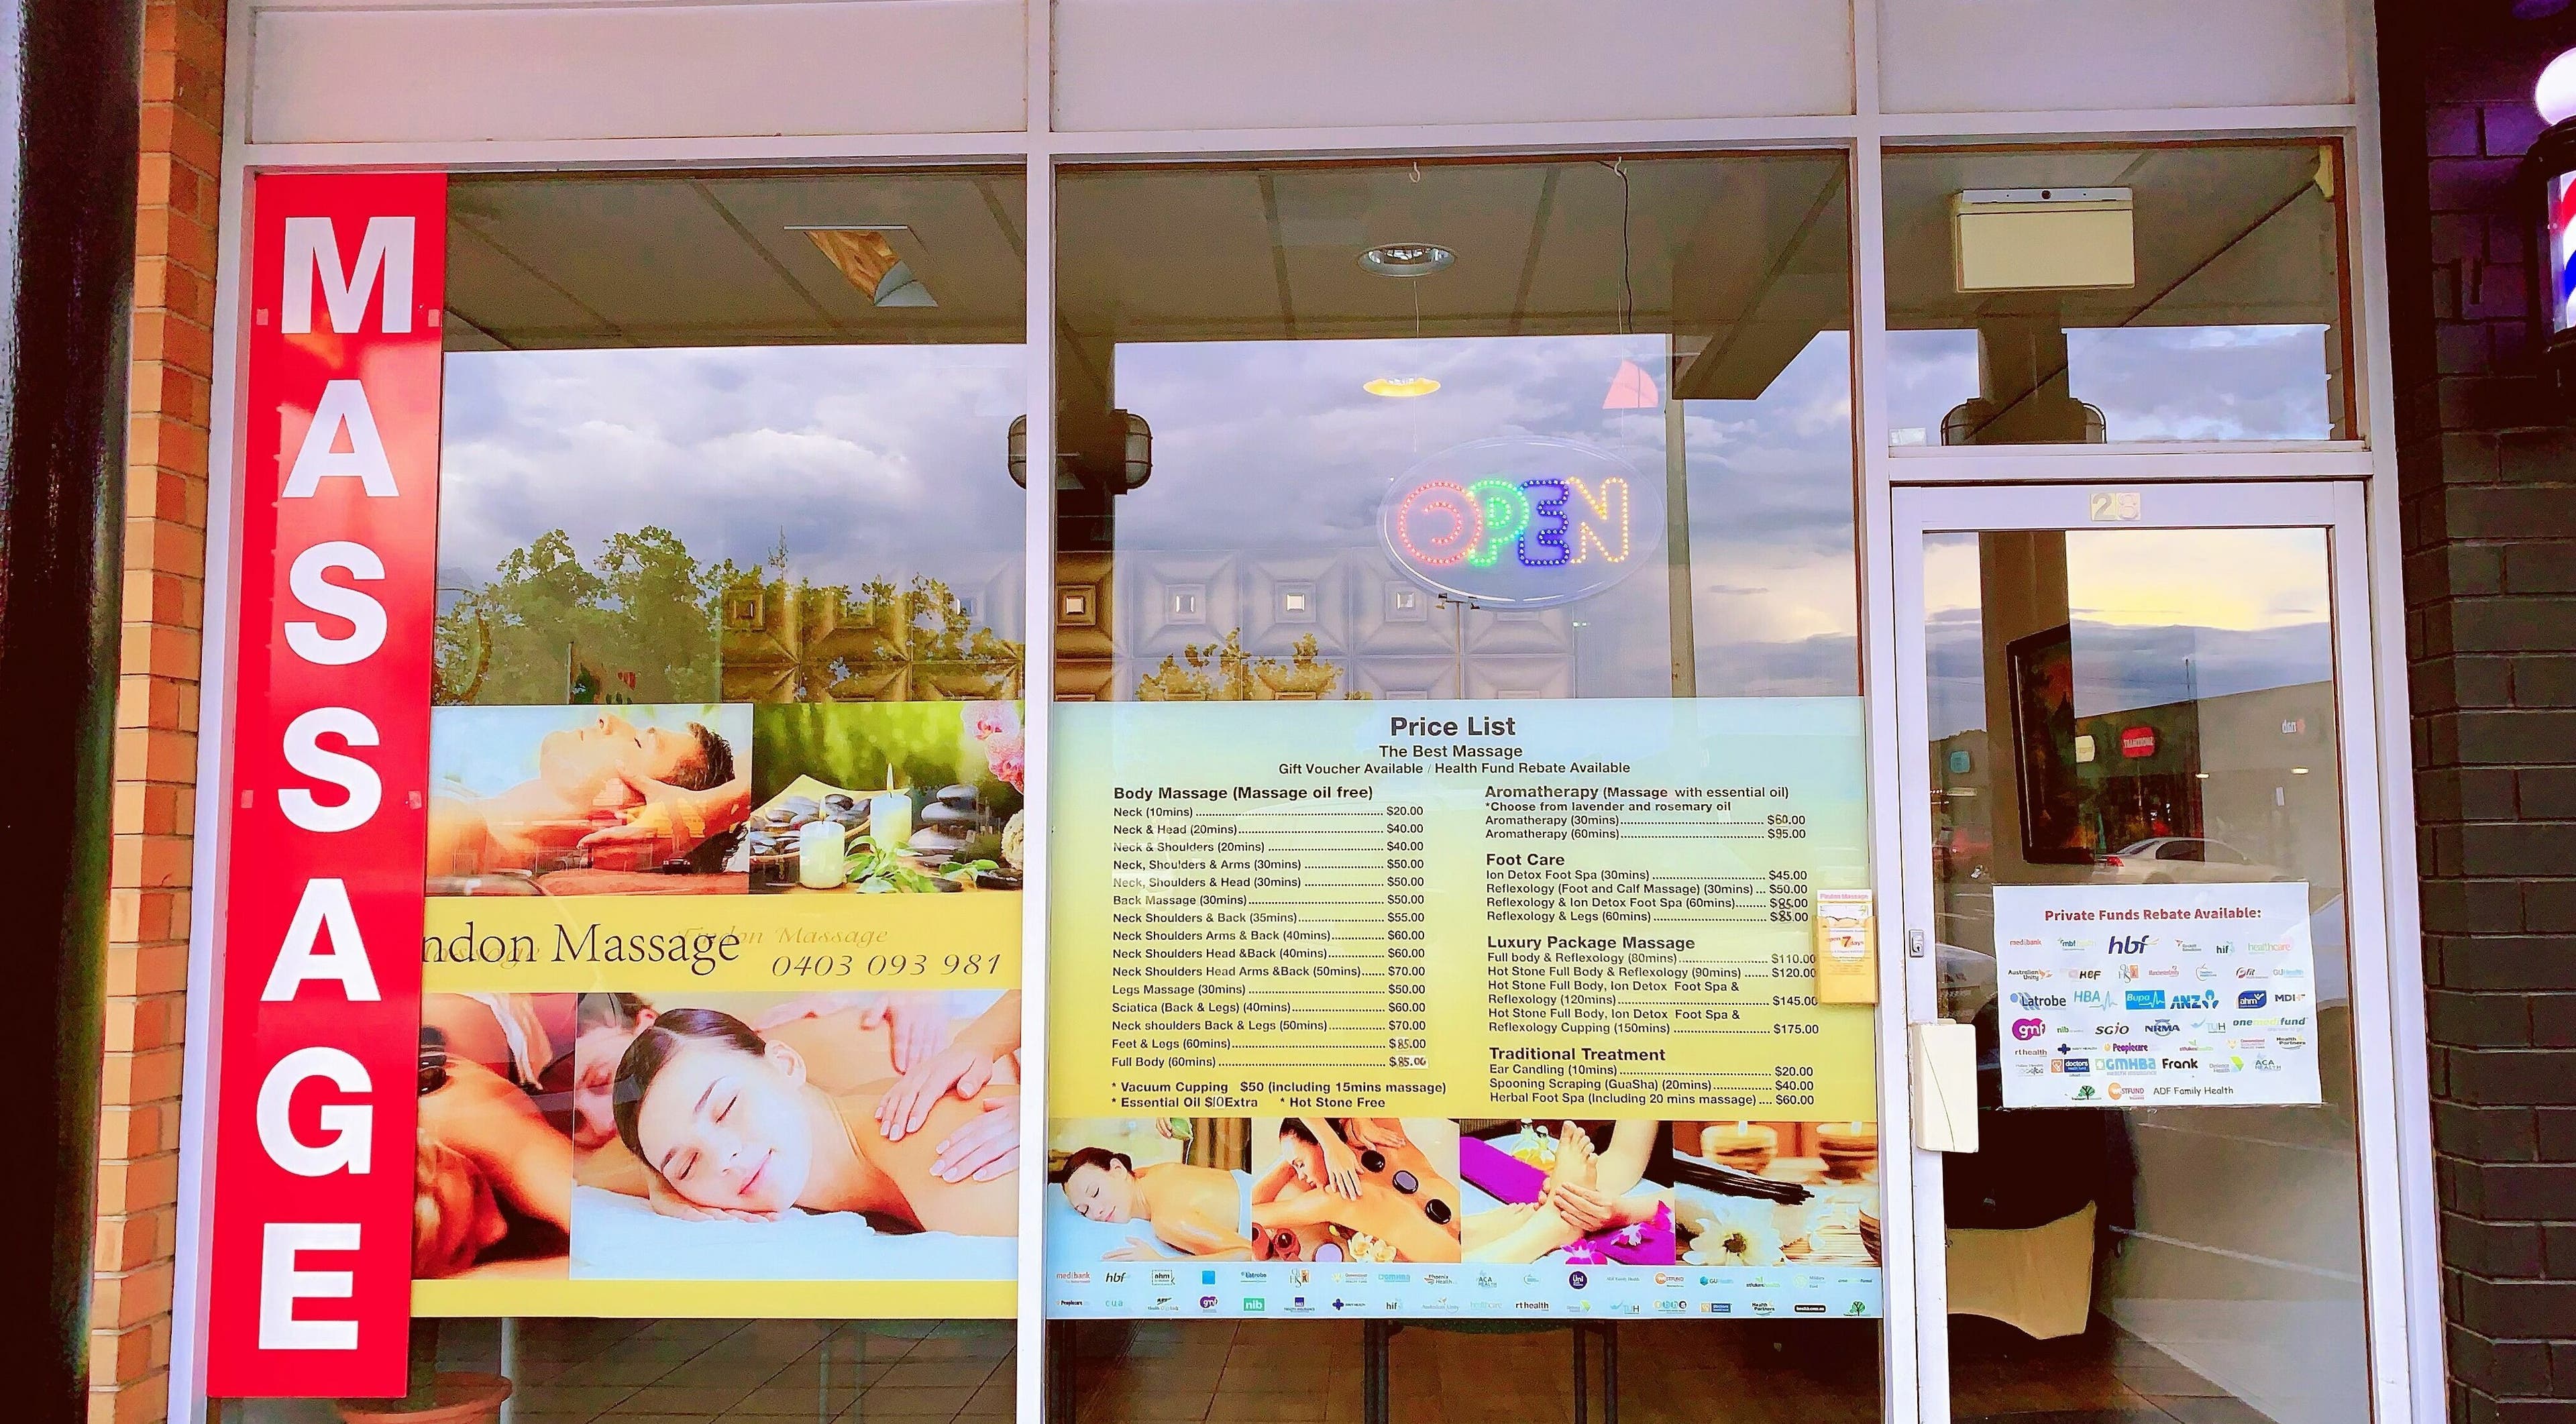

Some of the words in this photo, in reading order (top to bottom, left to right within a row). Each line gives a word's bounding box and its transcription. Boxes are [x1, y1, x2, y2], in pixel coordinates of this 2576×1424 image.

[1398, 476, 1629, 566] OPEN
[1391, 716, 1458, 736] Price
[1468, 716, 1516, 736] List
[1379, 745, 1408, 758] The
[1413, 745, 1448, 758] Best
[1452, 745, 1523, 761] Massage
[1279, 763, 1303, 775] Gift
[1305, 763, 1361, 775] Voucher
[1363, 763, 1424, 774] Available
[1435, 762, 1477, 774] Health
[1481, 762, 1515, 774] Fund
[1518, 762, 1566, 773] Rebate
[1569, 761, 1631, 773] Available
[256, 215, 416, 1351] MASSAGE
[1114, 787, 1153, 802] Body
[1158, 787, 1228, 802] Massage
[1233, 786, 1308, 802] (Massage
[1313, 785, 1332, 799] oil
[1336, 785, 1373, 801] free)
[1484, 785, 1599, 800] Aromatherapy
[1603, 786, 1668, 800] (Massage
[1674, 786, 1703, 798] with
[1706, 786, 1766, 798] essential
[1769, 786, 1789, 800] oil)
[1114, 807, 1143, 817] Neck
[1146, 806, 1193, 819] (10mins)
[1386, 805, 1424, 816] $20.00
[1540, 802, 1568, 812] from
[1572, 801, 1625, 812] lavender
[1628, 801, 1651, 812] and
[1655, 802, 1713, 814] rosemary
[1716, 801, 1731, 811] oil
[1485, 815, 1568, 828] Aromatherapy
[1570, 814, 1622, 827] (30mins)
[1767, 814, 1806, 827] $60.00
[1114, 824, 1143, 834] Neck
[1157, 824, 1187, 834] Head
[1190, 824, 1240, 836] (20mins)
[1386, 823, 1424, 834] $40.00
[1485, 828, 1568, 841] Aromatherapy
[1570, 828, 1622, 841] (60mins)
[1767, 826, 1807, 840] $95.00
[1486, 853, 1522, 866] Foot
[1527, 853, 1566, 866] Care
[1486, 869, 1504, 880] Ion
[1507, 869, 1542, 880] Detox
[1545, 869, 1572, 880] Foot
[1574, 869, 1597, 882] Spa
[1601, 869, 1650, 882] (30mins)
[1768, 869, 1807, 881] $45.00
[1113, 895, 1142, 906] Back
[1145, 895, 1197, 908] Massage
[1199, 894, 1247, 907] (30mins)
[1387, 893, 1424, 905] $50.00
[2045, 910, 2095, 921] Private
[2098, 909, 2140, 921] Funds
[2143, 908, 2192, 920] Rebate
[2194, 907, 2261, 919] Available:
[421, 920, 537, 963] ndon
[551, 923, 741, 976] Massage
[1487, 935, 1542, 951] Luxury
[1547, 936, 1617, 952] Package
[1623, 936, 1695, 952] Massage
[2108, 935, 2149, 954] hbf
[2216, 944, 2229, 954] hif
[772, 954, 853, 977] 0403
[867, 954, 927, 977] 093
[941, 953, 1001, 976] 981
[1112, 985, 1140, 997] Legs
[1143, 984, 1195, 997] Massage
[1198, 983, 1246, 997] (30mins)
[1388, 983, 1426, 995] $50.00
[2074, 991, 2101, 1003] HBA
[2021, 995, 2067, 1007] Latrobe
[2127, 993, 2150, 1002] Bupa
[2170, 995, 2202, 1009] ANZ
[1489, 1022, 1558, 1035] Reflexology
[1560, 1022, 1610, 1035] Cupping
[1613, 1022, 1670, 1036] (150mins)
[1773, 1023, 1819, 1035] $175.00
[2145, 1024, 2180, 1032] NRMA
[1489, 1046, 1576, 1060] Traditional
[1580, 1047, 1666, 1061] Treatment
[1112, 1056, 1132, 1067] Full
[1135, 1056, 1165, 1069] Body
[1168, 1056, 1216, 1069] (60mins)
[2162, 1058, 2198, 1069] Frank
[1489, 1063, 1510, 1075] Ear
[1512, 1063, 1564, 1077] Candling
[1568, 1064, 1617, 1077] (10mins)
[1774, 1065, 1813, 1077] $20.00
[1120, 1081, 1171, 1093] Vacuum
[1175, 1081, 1228, 1096] Cupping
[1240, 1080, 1265, 1093] $50
[1268, 1081, 1331, 1095] (including
[1335, 1081, 1382, 1093] 15mins
[1385, 1082, 1446, 1095] massage)
[1489, 1077, 1545, 1091] Spooning
[1548, 1077, 1601, 1091] Scraping
[1605, 1079, 1658, 1092] (GuaSha)
[1662, 1079, 1715, 1093] (20mins)
[1774, 1079, 1814, 1092] $40.00
[2174, 1087, 2202, 1097] Family
[2204, 1086, 2234, 1095] Health
[1121, 1097, 1179, 1108] Essential
[1183, 1097, 1201, 1107] Oil
[1289, 1097, 1312, 1108] Hot
[1316, 1095, 1353, 1108] Stone
[1357, 1097, 1386, 1108] Free
[1490, 1091, 1529, 1103] Herbal
[1532, 1092, 1559, 1103] Foot
[1561, 1092, 1585, 1105] Spa
[1588, 1093, 1646, 1106] (Including
[1650, 1093, 1664, 1104] 20
[1666, 1093, 1696, 1104] mins
[1699, 1094, 1756, 1107] massage)
[1775, 1093, 1815, 1105] $60.00
